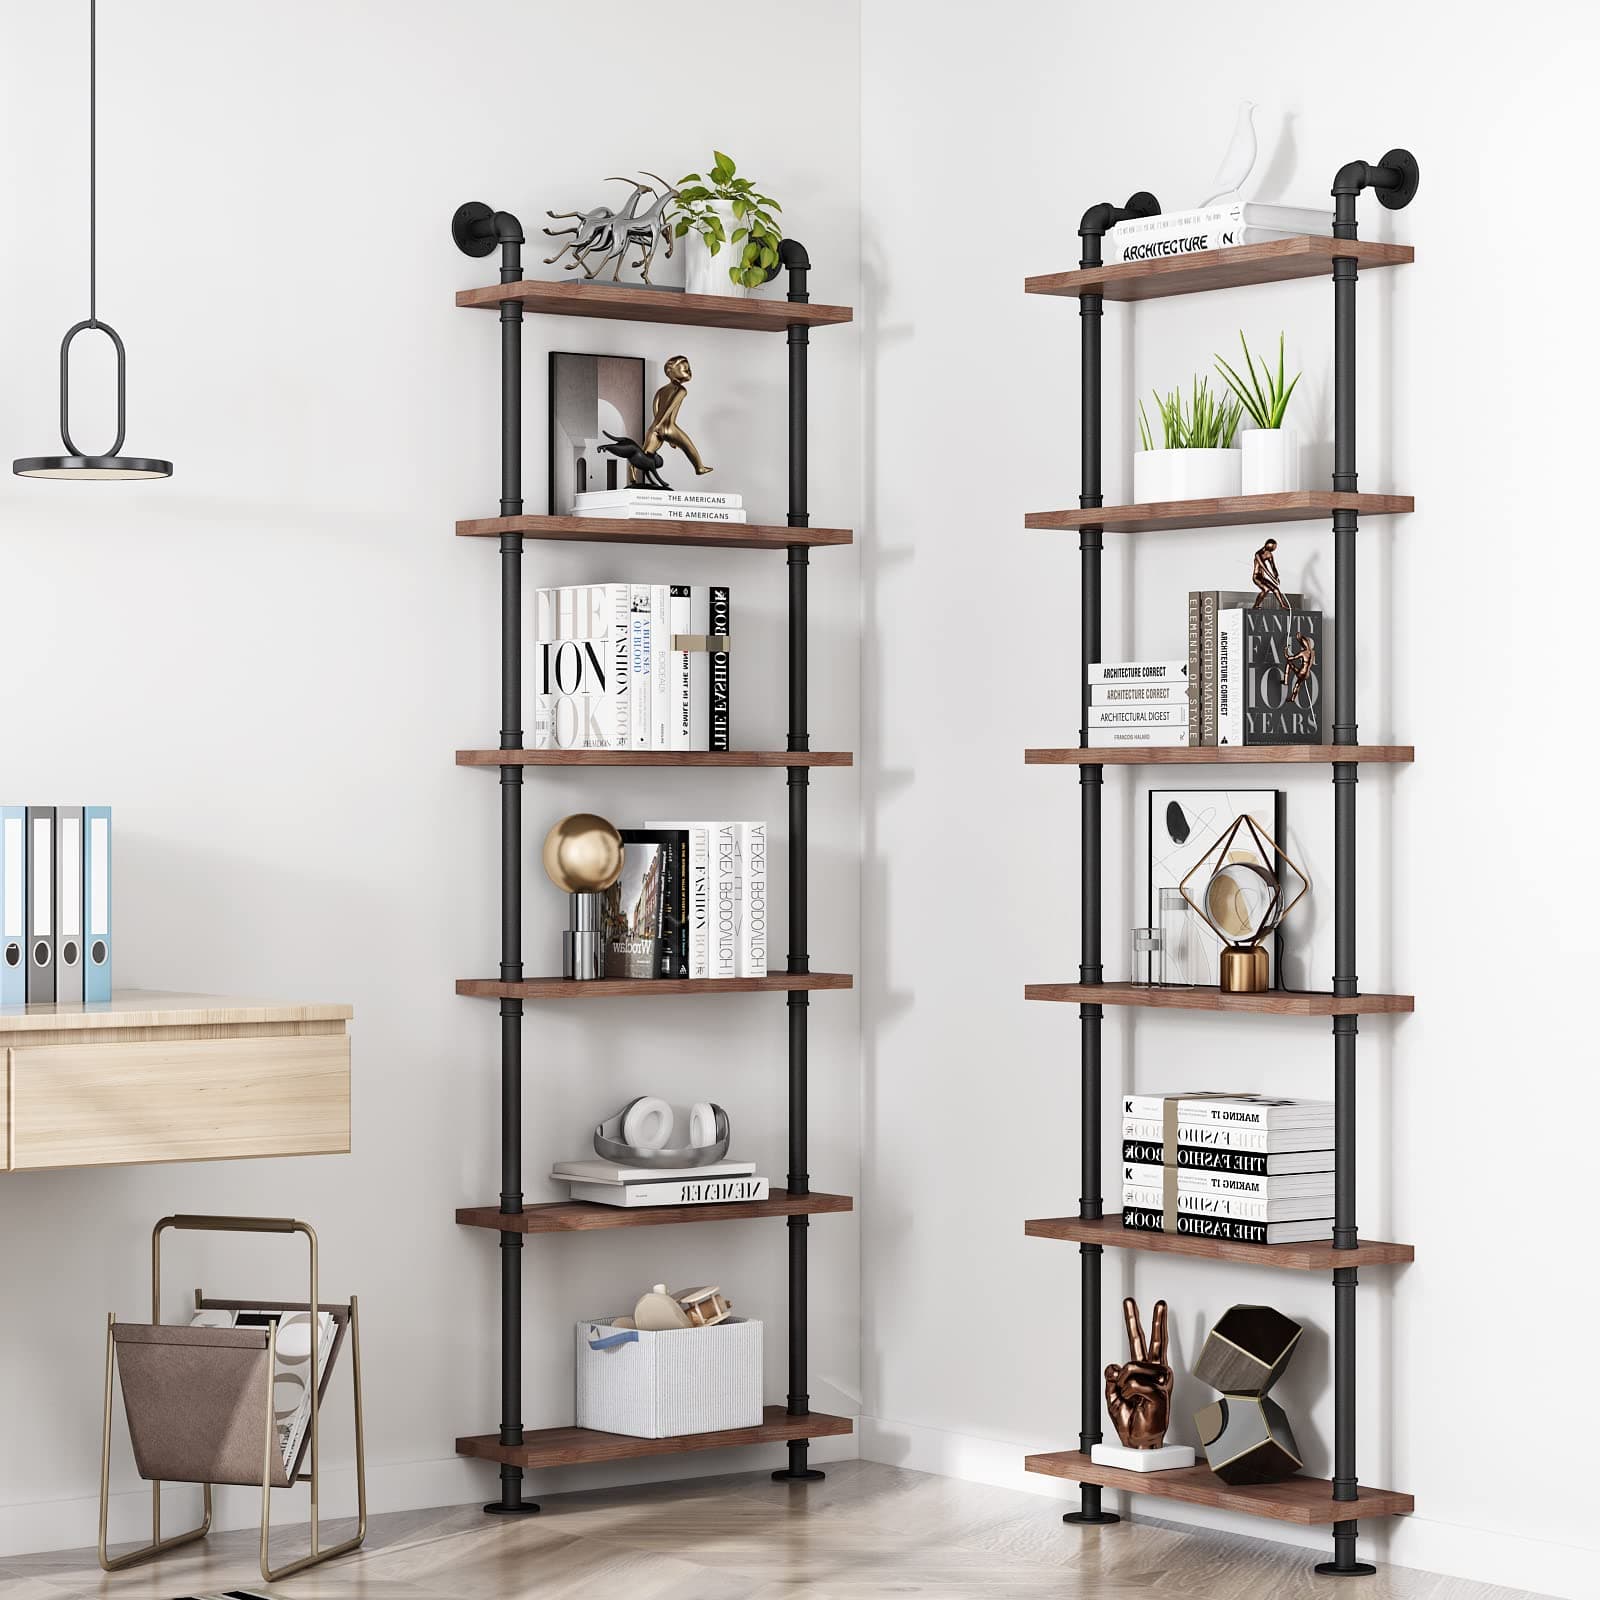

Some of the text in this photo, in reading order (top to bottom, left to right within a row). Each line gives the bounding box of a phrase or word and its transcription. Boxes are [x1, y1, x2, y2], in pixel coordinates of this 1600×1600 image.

[1123, 234, 1208, 261] ARCHITECTURE
[684, 495, 726, 504] AMERICANS
[668, 510, 683, 518] THE
[685, 511, 729, 520] AMERICANS
[1248, 615, 1317, 634] VANITY
[633, 621, 641, 673] OF BLOOD
[540, 641, 608, 695] ION
[616, 624, 628, 695] FASHION
[1204, 597, 1213, 739] COPYRIGHTED MATERIAL
[1104, 667, 1166, 678] ARCHITECTURE CORRECT
[1190, 674, 1197, 689] OF
[1220, 631, 1228, 716] ARCHITECTURE CORRECT
[1107, 688, 1169, 700] ARCHITECTURE CORRECT
[1100, 712, 1147, 721] ARCHITECTURAL
[1148, 711, 1170, 720] DIGEST
[1246, 712, 1318, 734] YEARS
[695, 866, 706, 929] FASHION
[1125, 1101, 1133, 1112] K
[1125, 1168, 1133, 1180] K
